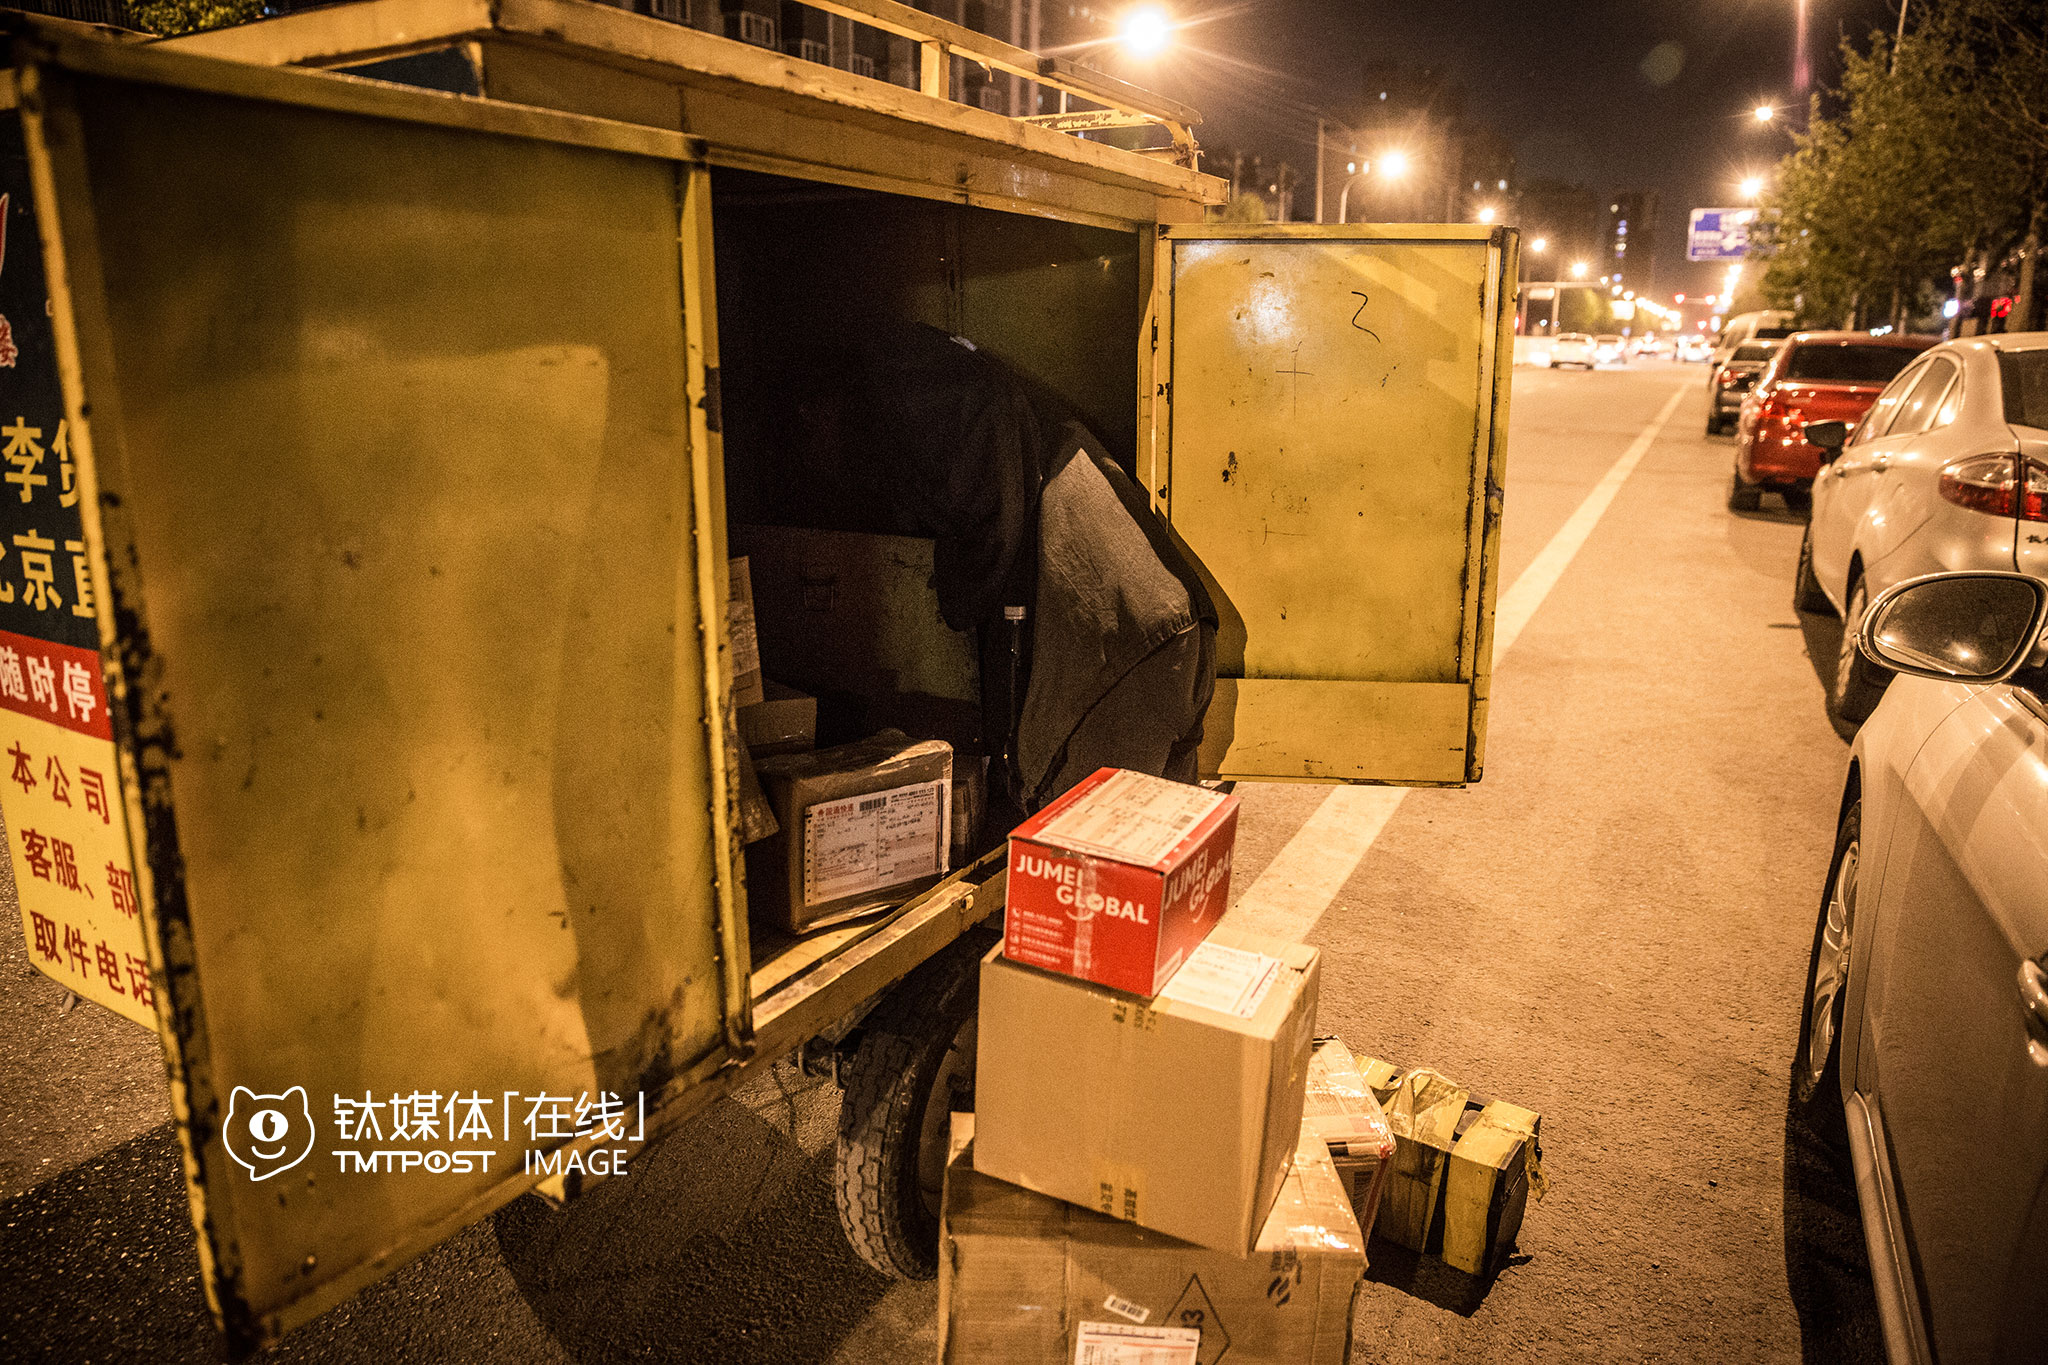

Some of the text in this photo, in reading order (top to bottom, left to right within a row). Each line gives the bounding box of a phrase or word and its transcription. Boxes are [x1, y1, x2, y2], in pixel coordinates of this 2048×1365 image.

[7, 740, 111, 826] 本公司
[1015, 855, 1083, 889] JUMEI
[1056, 885, 1149, 925] GLOBAL
[29, 909, 156, 1008] 取件电话
